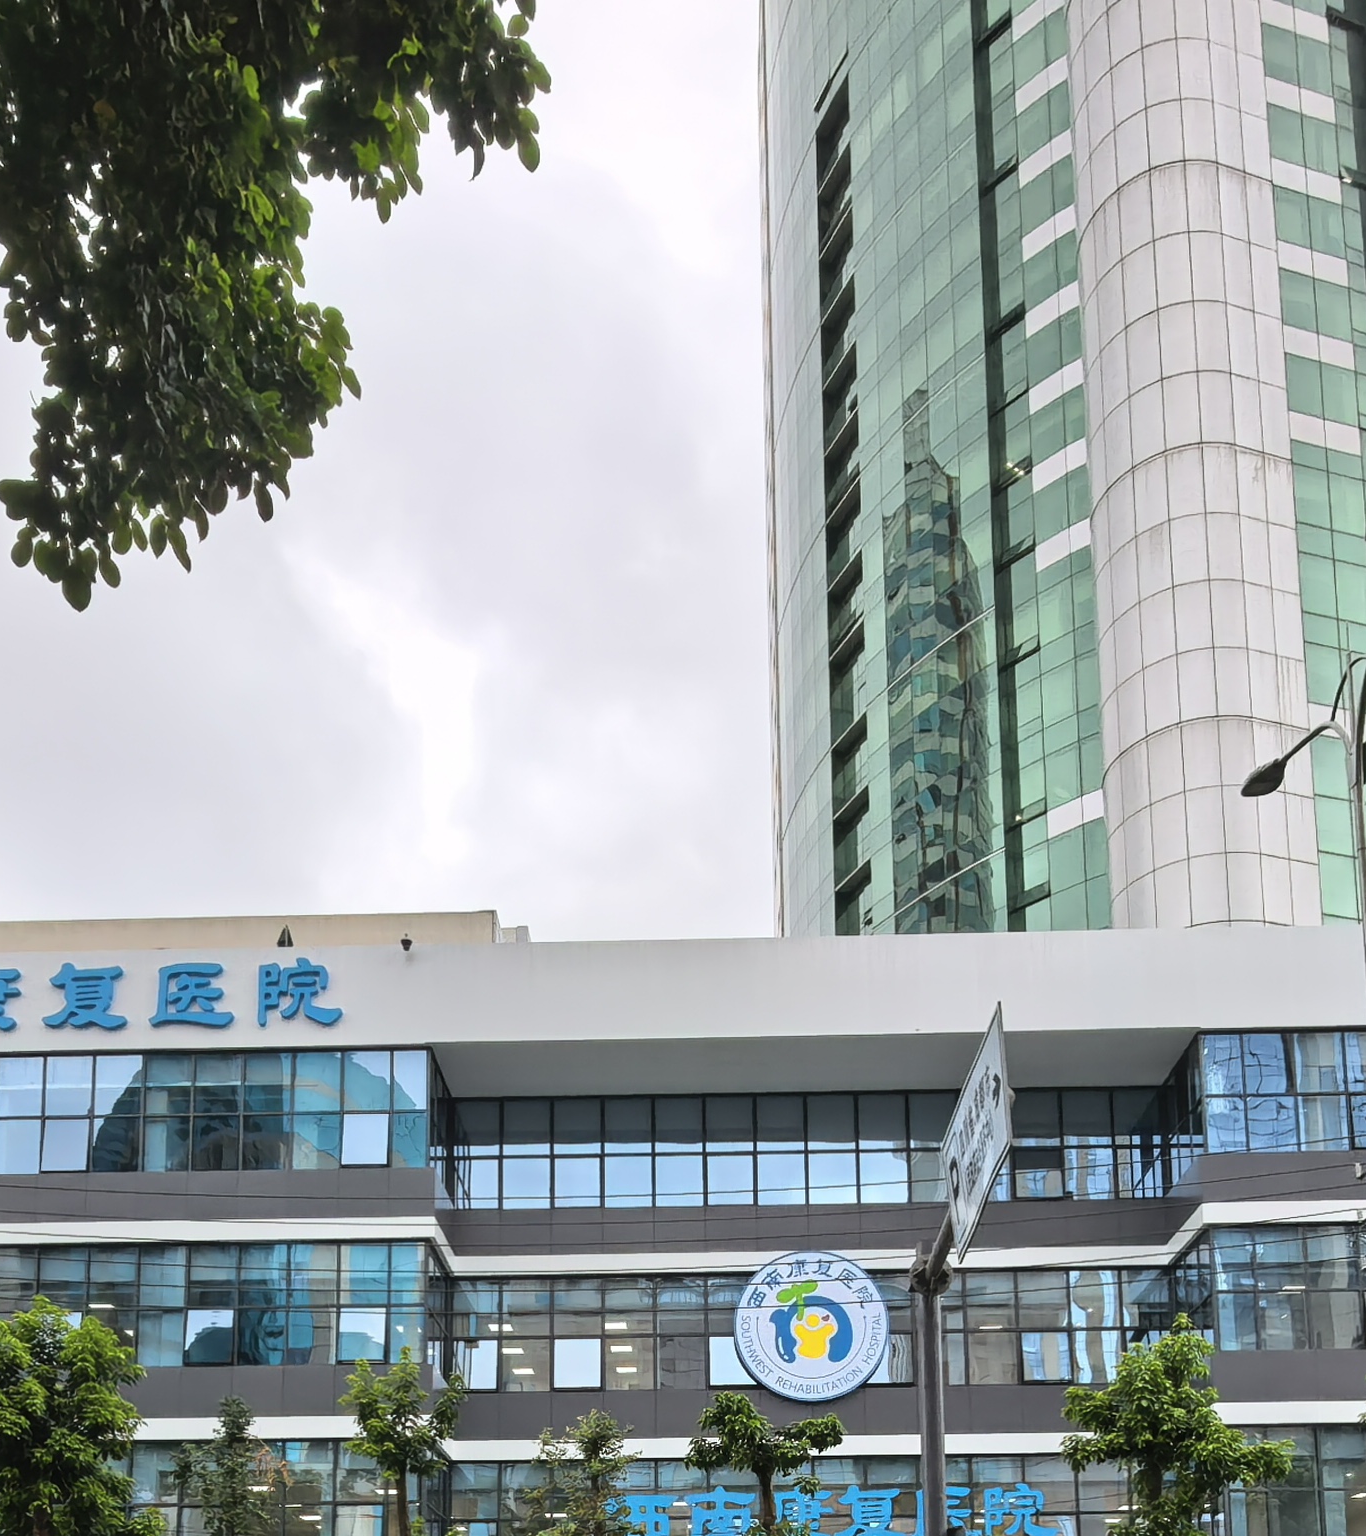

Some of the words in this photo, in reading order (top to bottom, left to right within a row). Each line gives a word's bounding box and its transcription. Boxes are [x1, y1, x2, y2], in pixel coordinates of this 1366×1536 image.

[746, 1258, 874, 1310] 西南康复医院
[741, 1315, 774, 1378] SOUTHWEST
[775, 1366, 864, 1395] REHABILITATION
[862, 1311, 882, 1366] HOSPITAL
